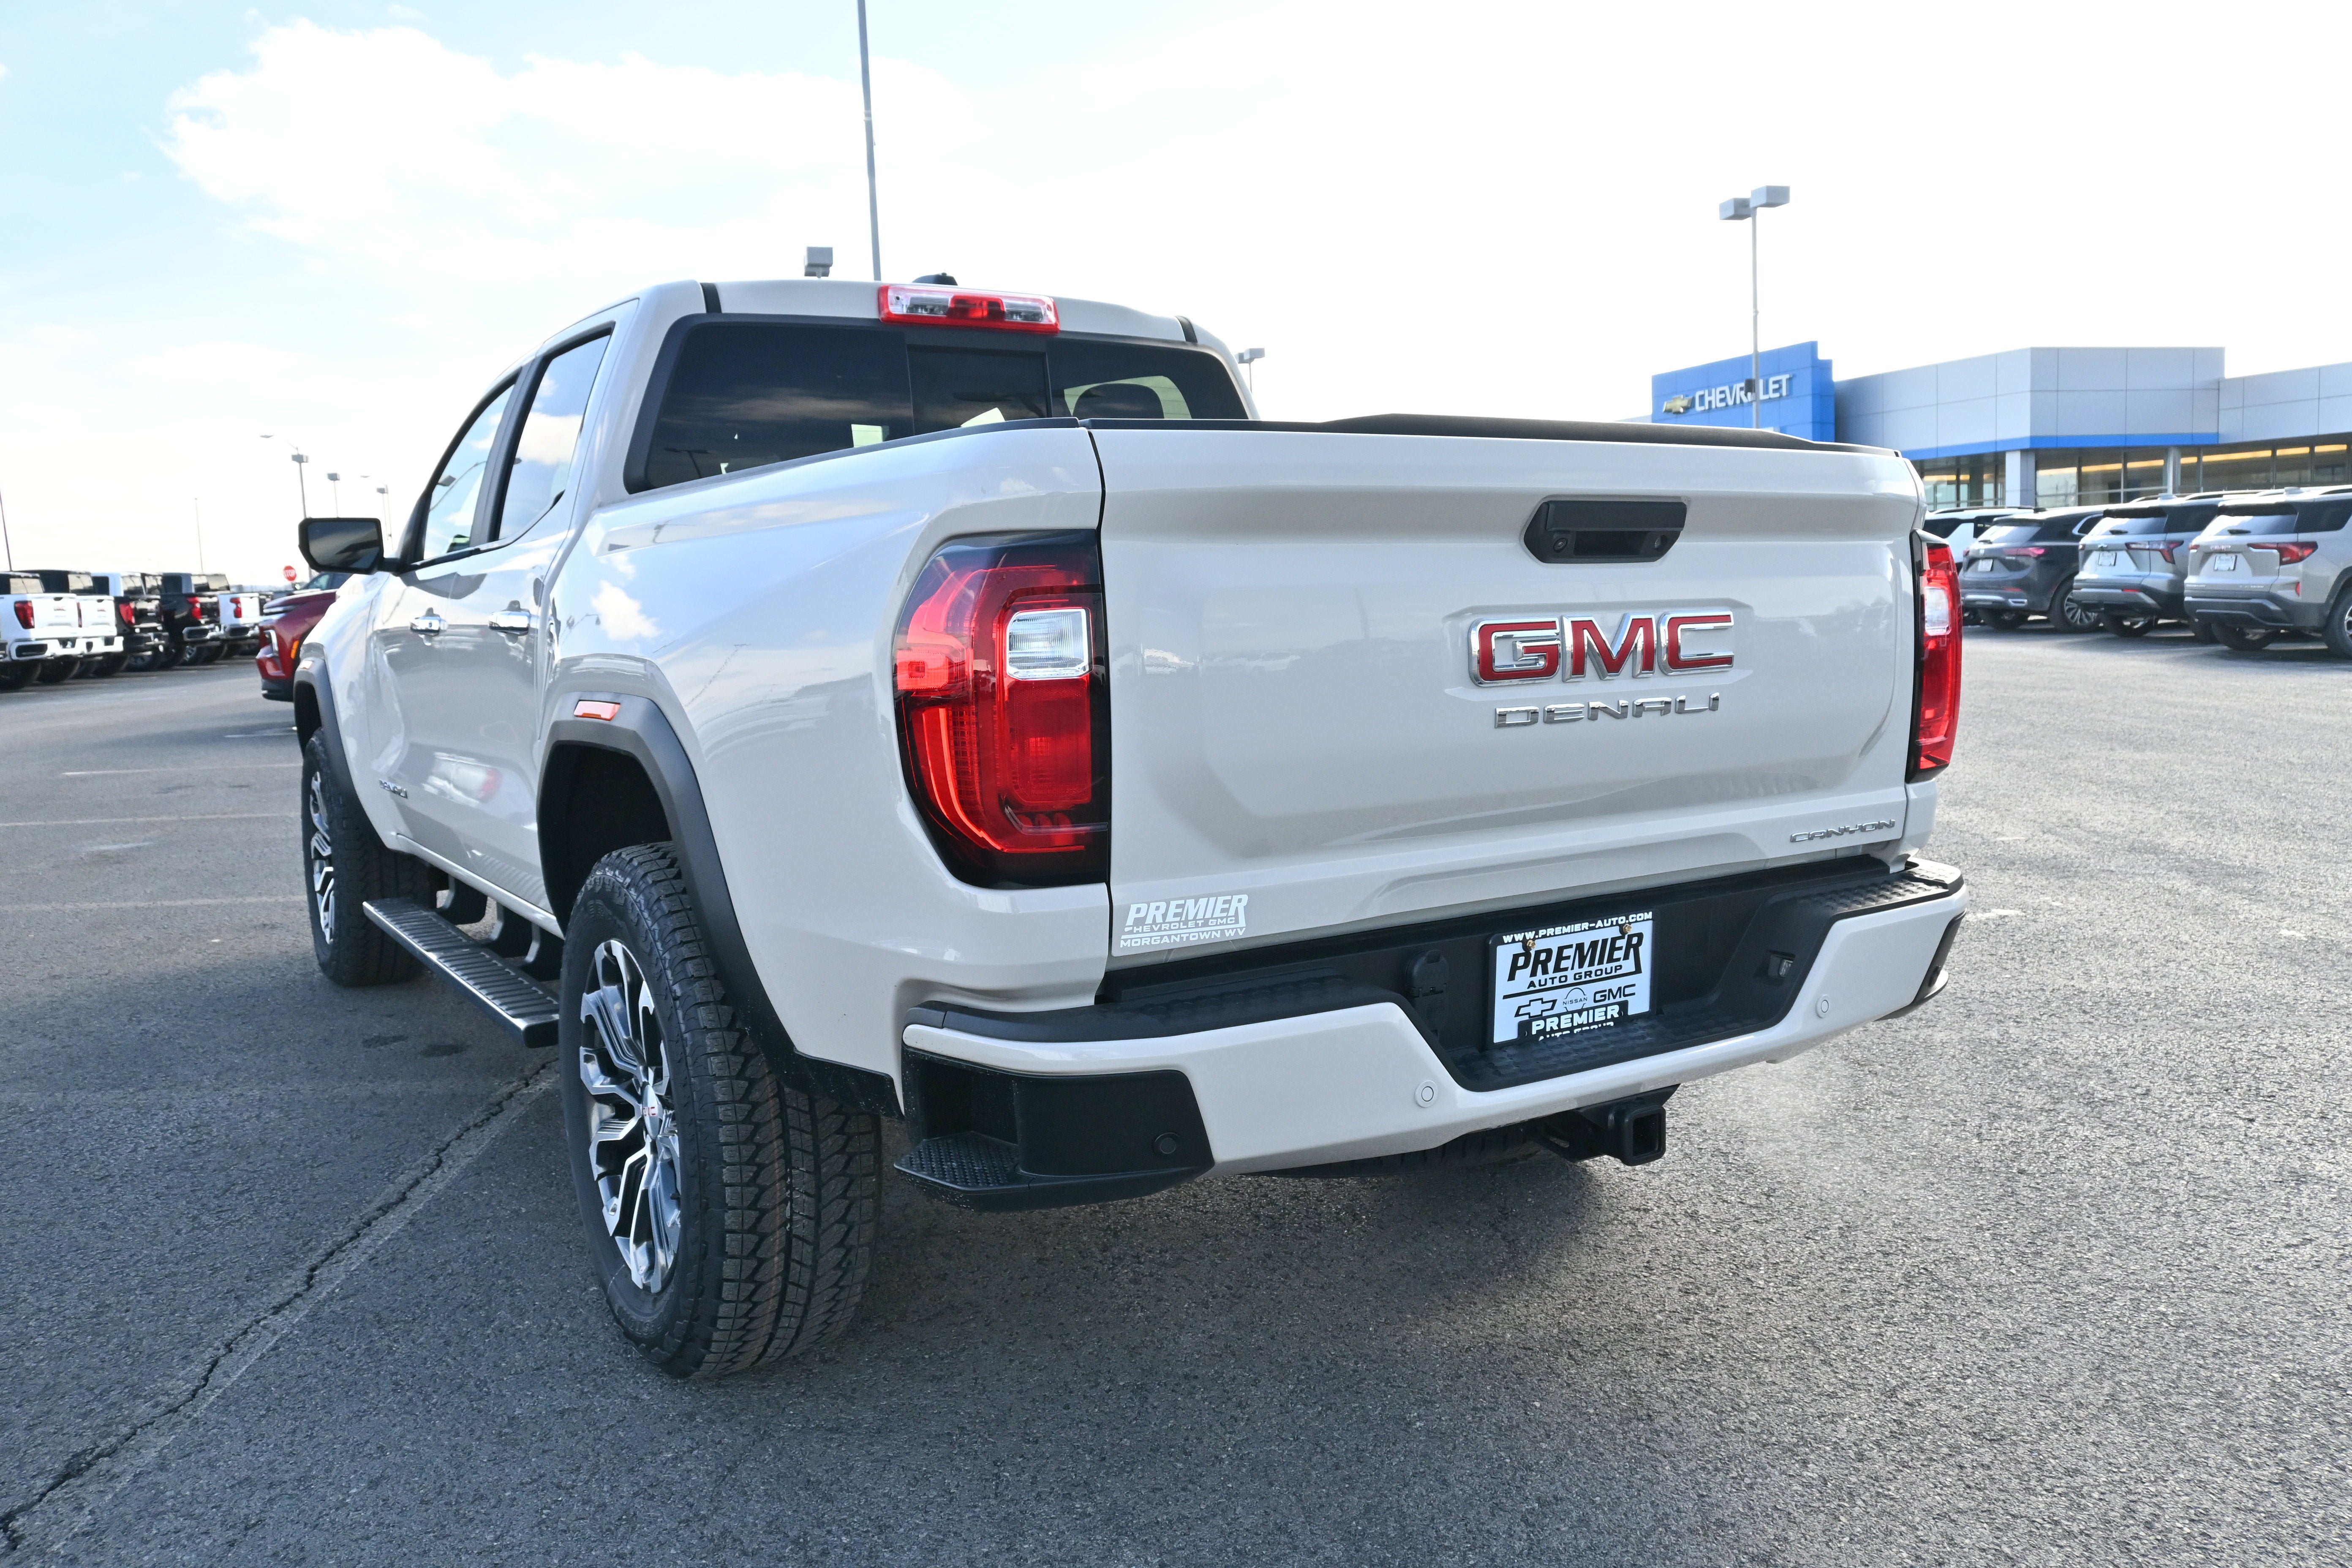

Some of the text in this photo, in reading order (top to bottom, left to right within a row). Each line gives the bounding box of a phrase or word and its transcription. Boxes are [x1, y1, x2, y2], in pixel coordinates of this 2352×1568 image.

[1695, 374, 1791, 411] CHEVRLET
[283, 569, 296, 578] STOP
[1468, 610, 1734, 687] GMC
[1494, 692, 1719, 729] DENALI
[1790, 819, 1896, 843] CANYON
[1125, 894, 1248, 926] PREMIER
[1209, 917, 1235, 926] GMC
[1120, 928, 1246, 948] MORGANTOWN WV
[1503, 912, 1652, 943] WWW.PREMIER-AUTO.COM
[1507, 932, 1644, 982] PREMIER
[1527, 964, 1623, 989] AUTO GROUP
[1563, 997, 1587, 1005] NISSAN
[1593, 983, 1636, 1003] GMC
[1532, 1004, 1619, 1035] PREMIER
